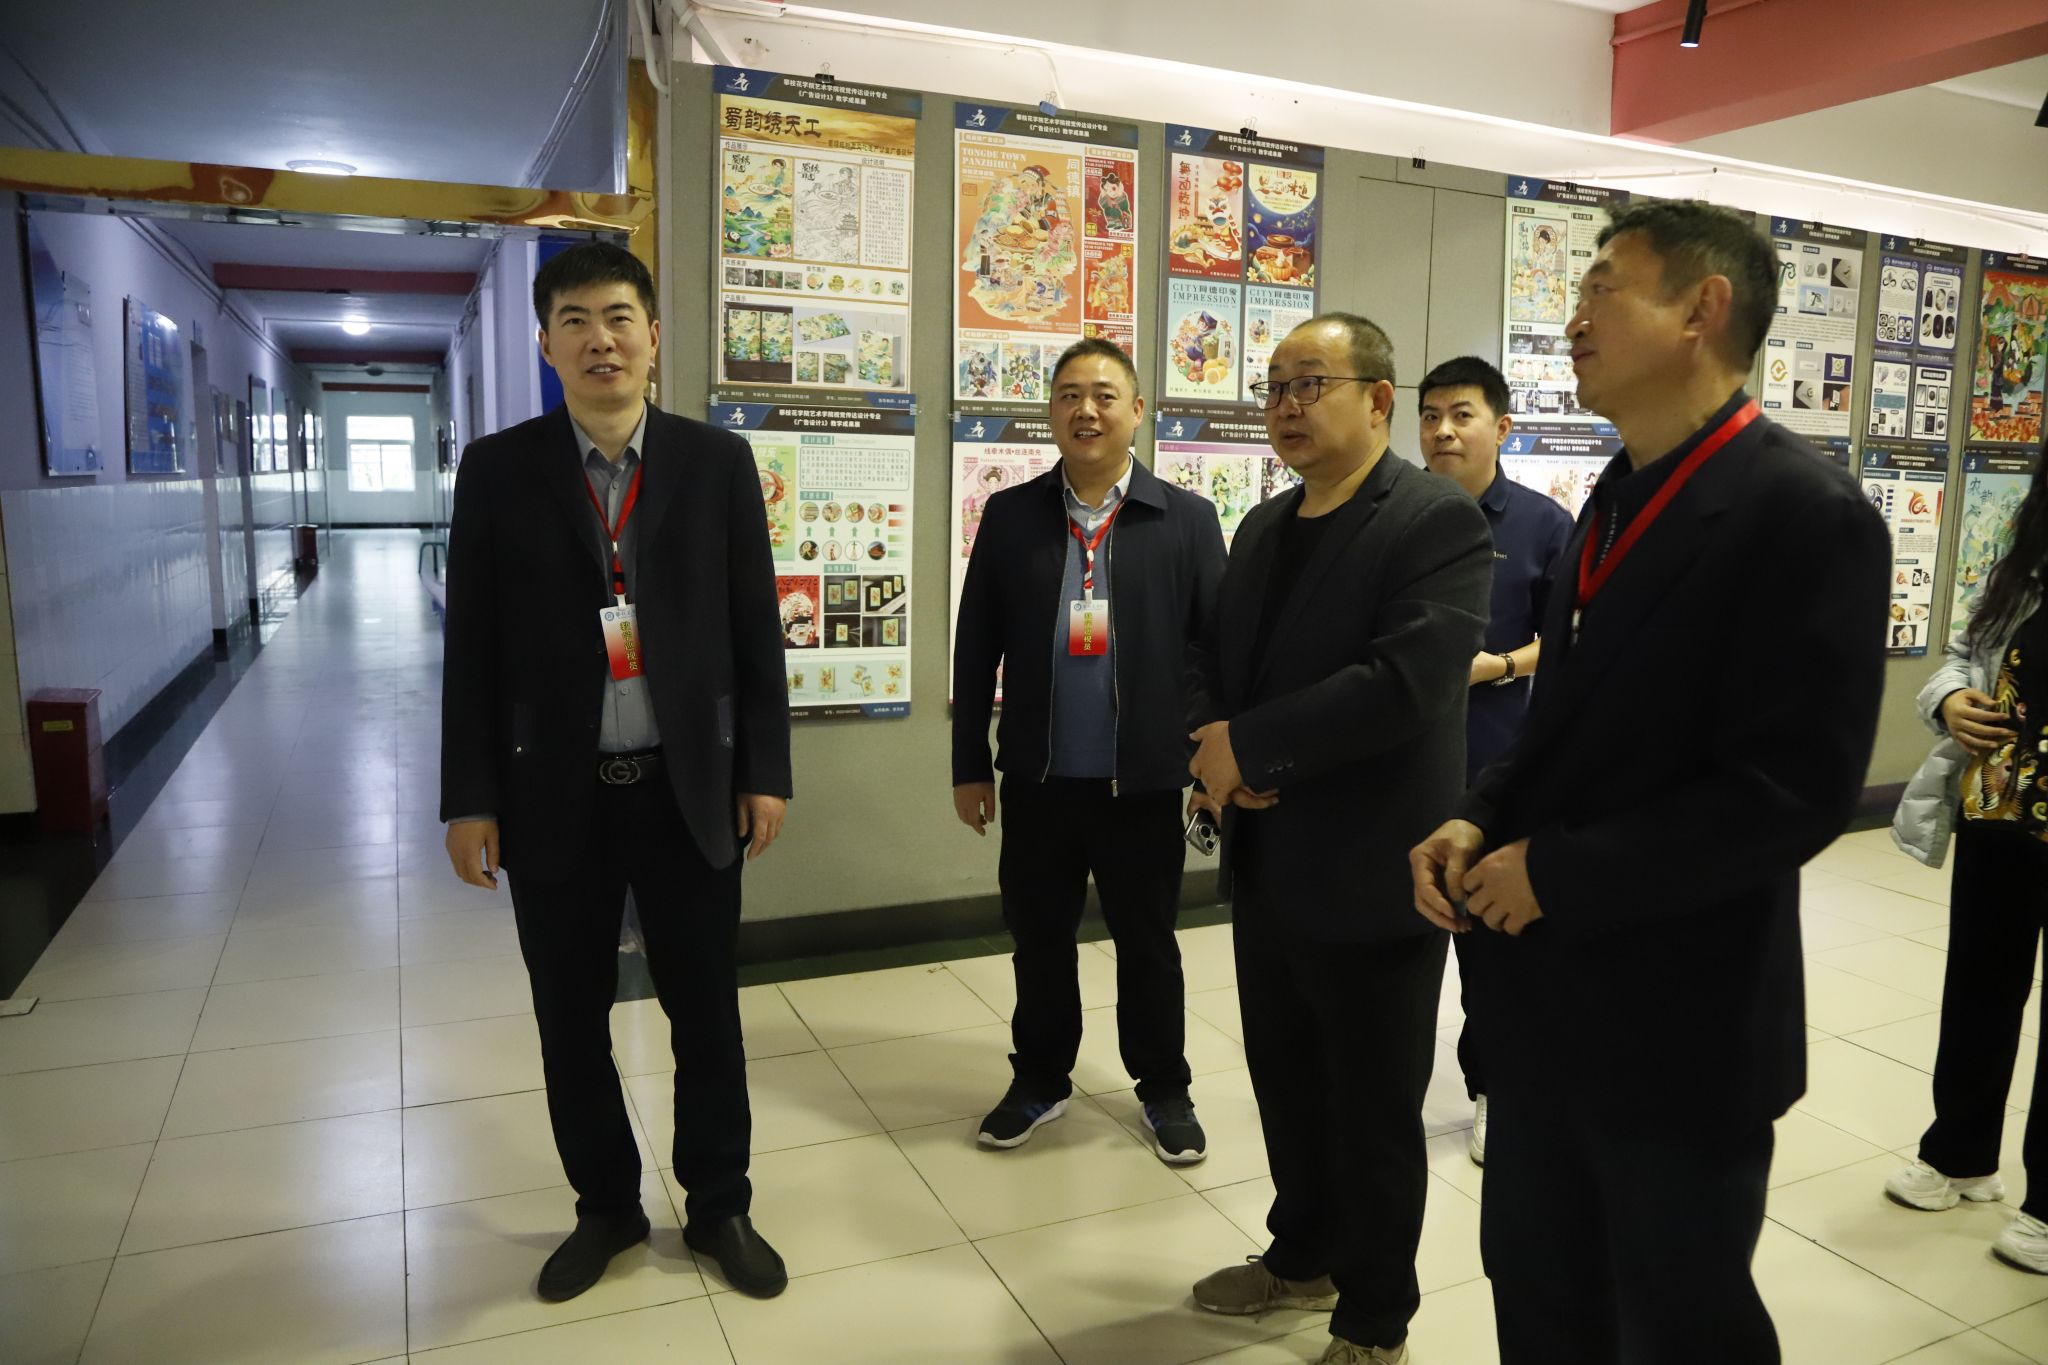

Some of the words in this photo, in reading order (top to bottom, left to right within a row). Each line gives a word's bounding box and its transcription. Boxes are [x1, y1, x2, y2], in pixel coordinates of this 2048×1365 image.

[725, 107, 822, 138] 蜀韵绣天工
[962, 147, 998, 159] TONGDE
[1000, 151, 1027, 162] TOWN
[962, 157, 1018, 170] PANZHIHUA
[1067, 159, 1081, 198] 同德镇
[1173, 292, 1237, 304] IMPRESSION
[1250, 297, 1311, 309] IMPRESSION
